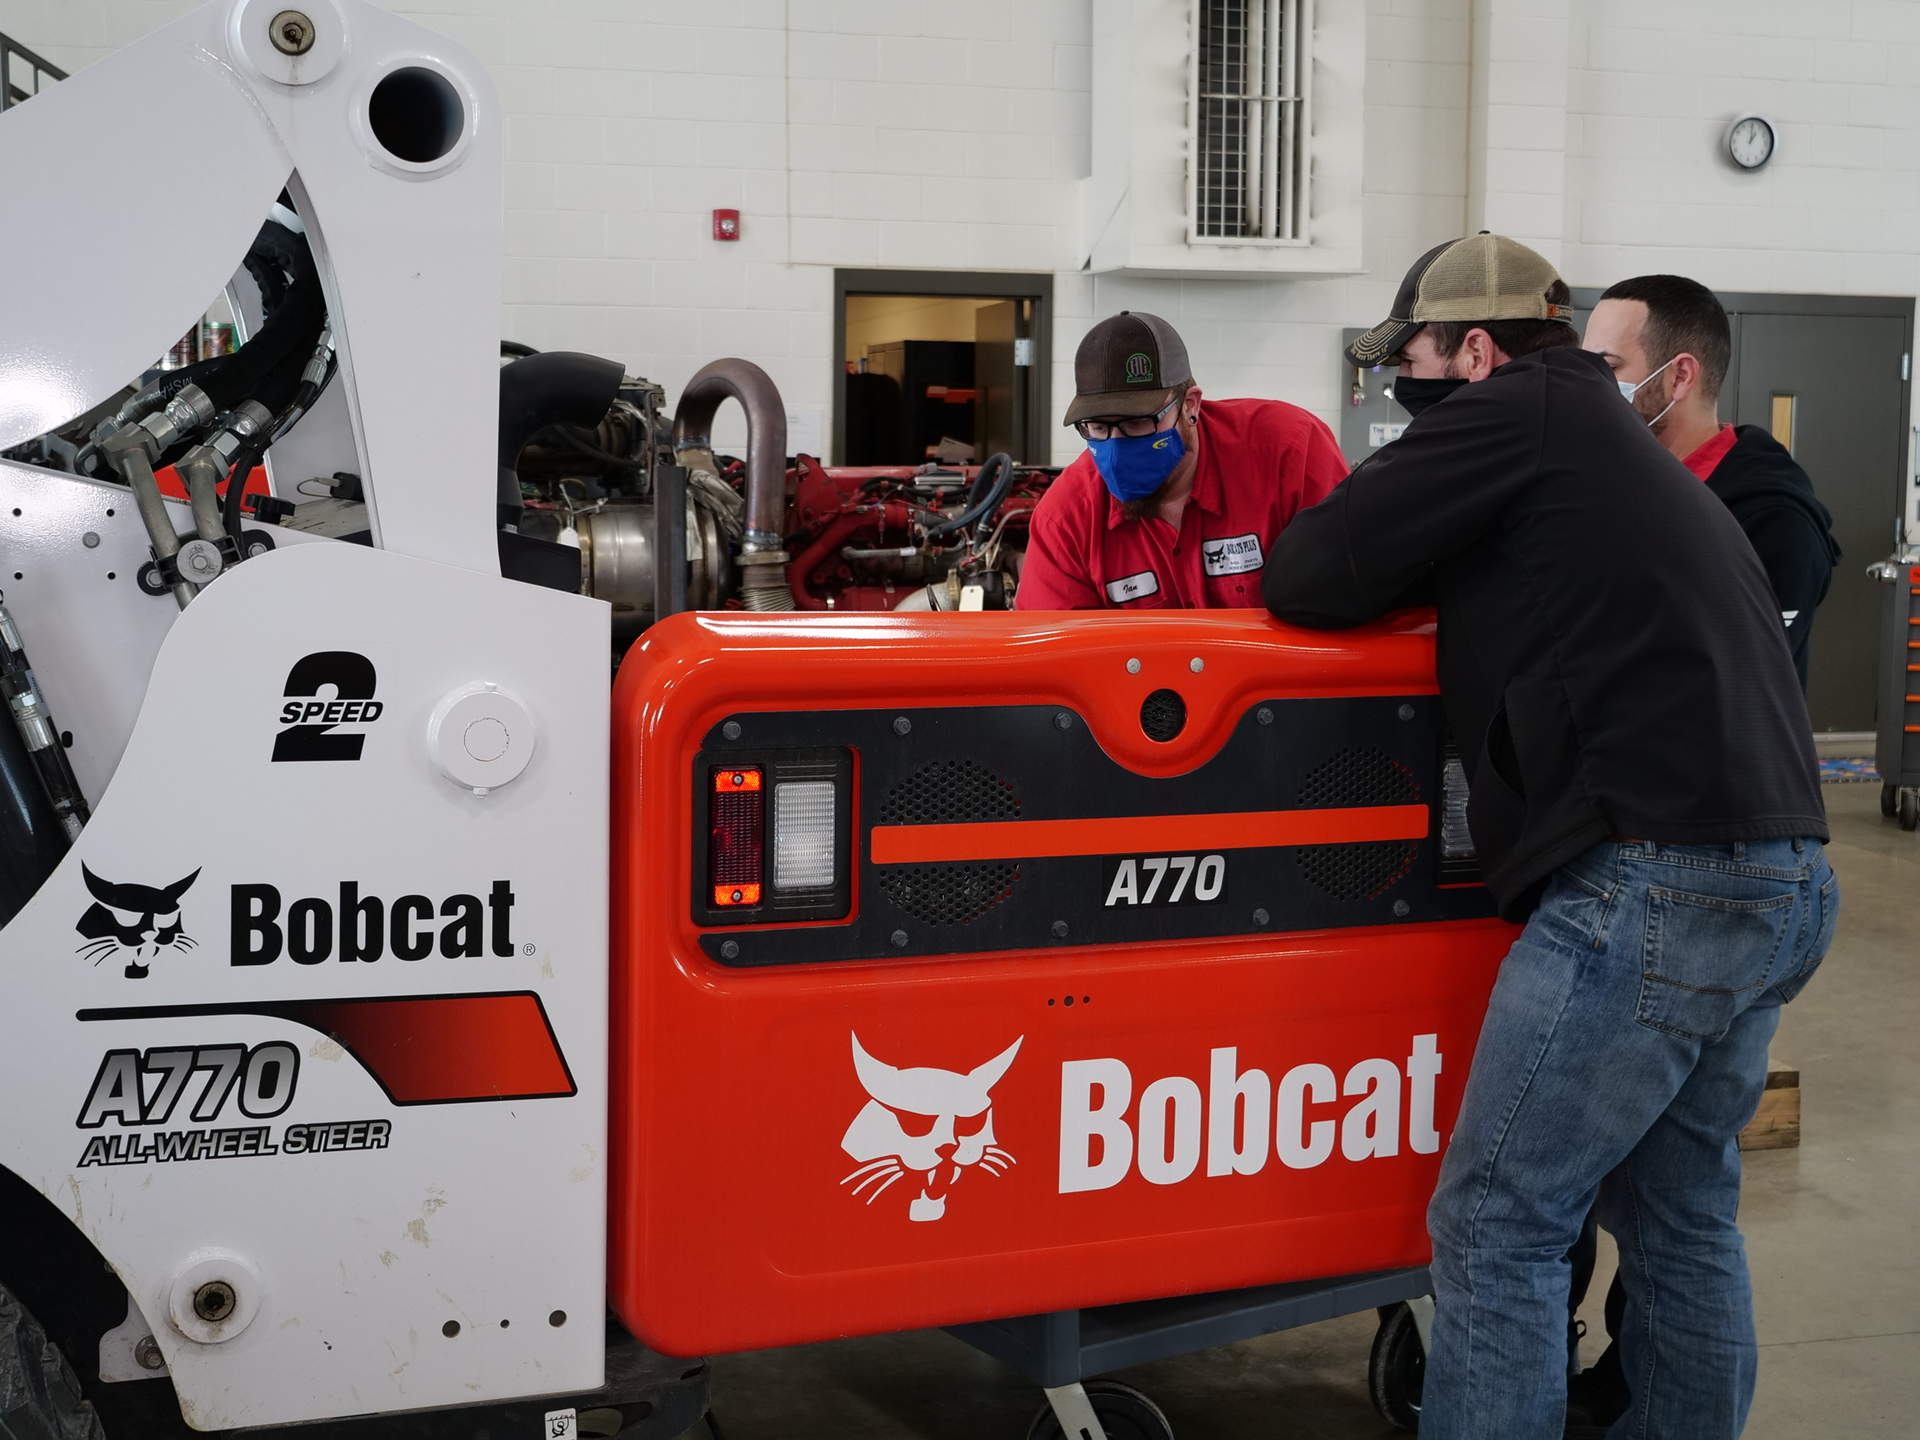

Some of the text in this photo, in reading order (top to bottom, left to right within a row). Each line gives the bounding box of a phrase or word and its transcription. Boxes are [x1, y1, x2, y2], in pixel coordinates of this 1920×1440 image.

[271, 651, 376, 761] 2
[279, 700, 383, 723] SPEED
[230, 879, 515, 967] Bobcat
[1105, 854, 1226, 907] A770
[76, 1041, 300, 1129] A770
[1058, 1033, 1442, 1195] Bobcat
[77, 1119, 391, 1168] ALL-WHEEL STEER
